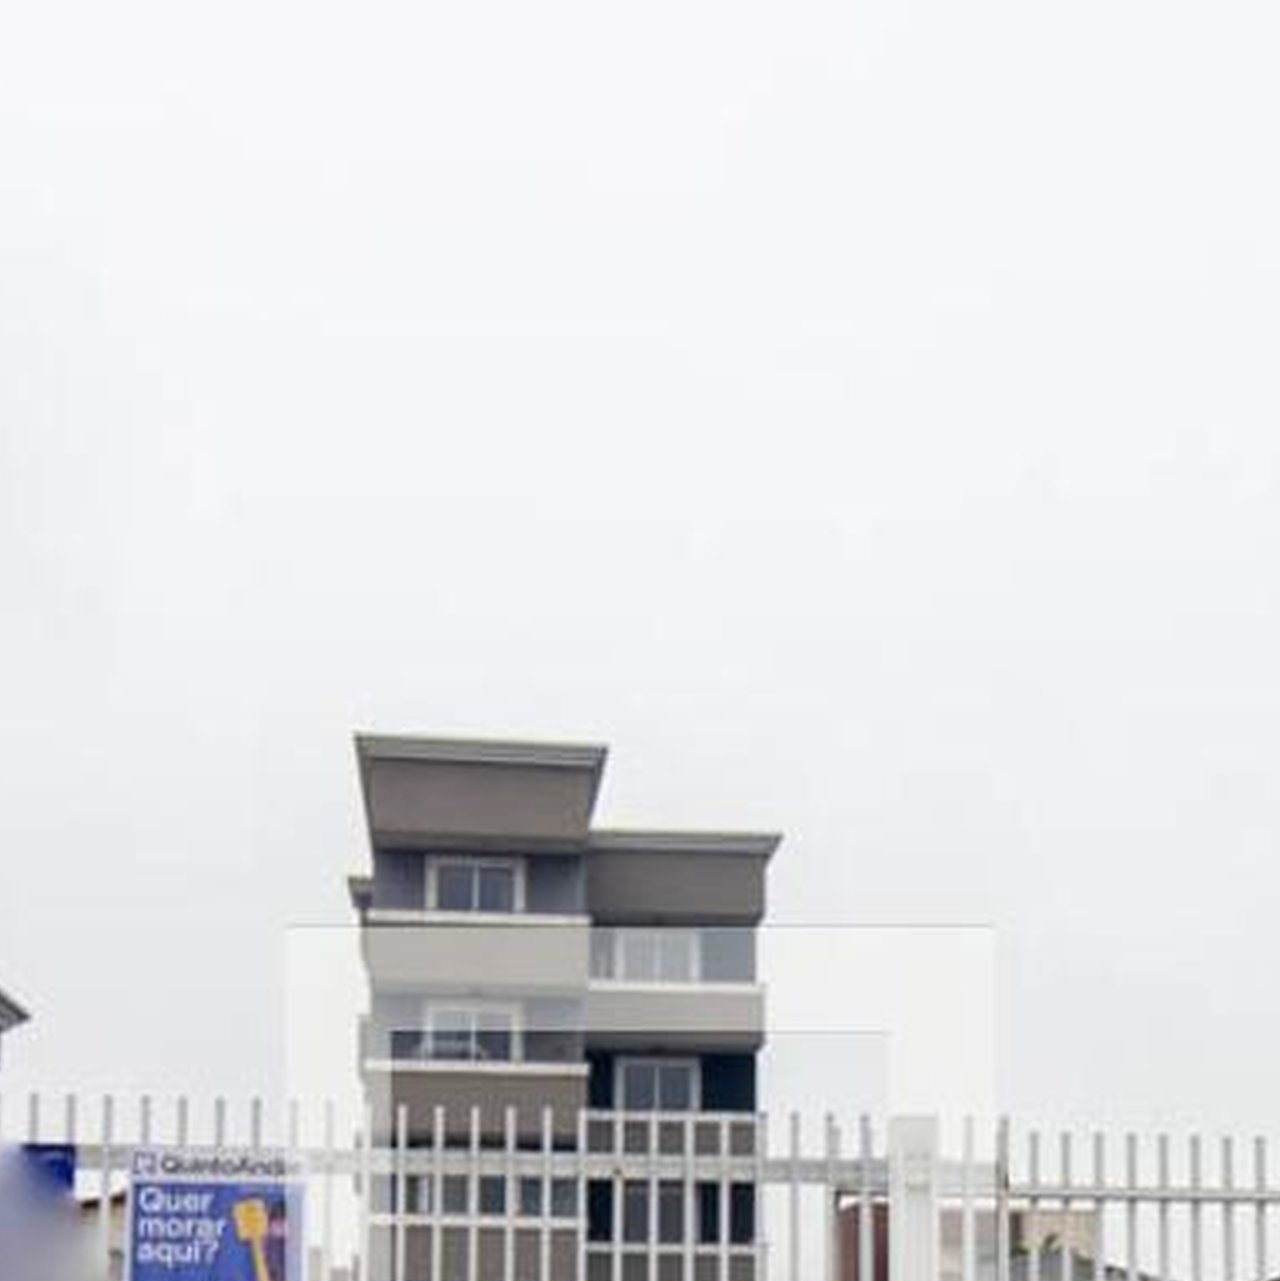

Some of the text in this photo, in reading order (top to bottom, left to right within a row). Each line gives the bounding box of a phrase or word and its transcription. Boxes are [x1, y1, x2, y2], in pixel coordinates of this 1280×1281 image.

[161, 1156, 302, 1176] QuintoAnd
[139, 1187, 214, 1213] Quer
[139, 1218, 226, 1238] morar
[137, 1241, 219, 1268] aqui?
